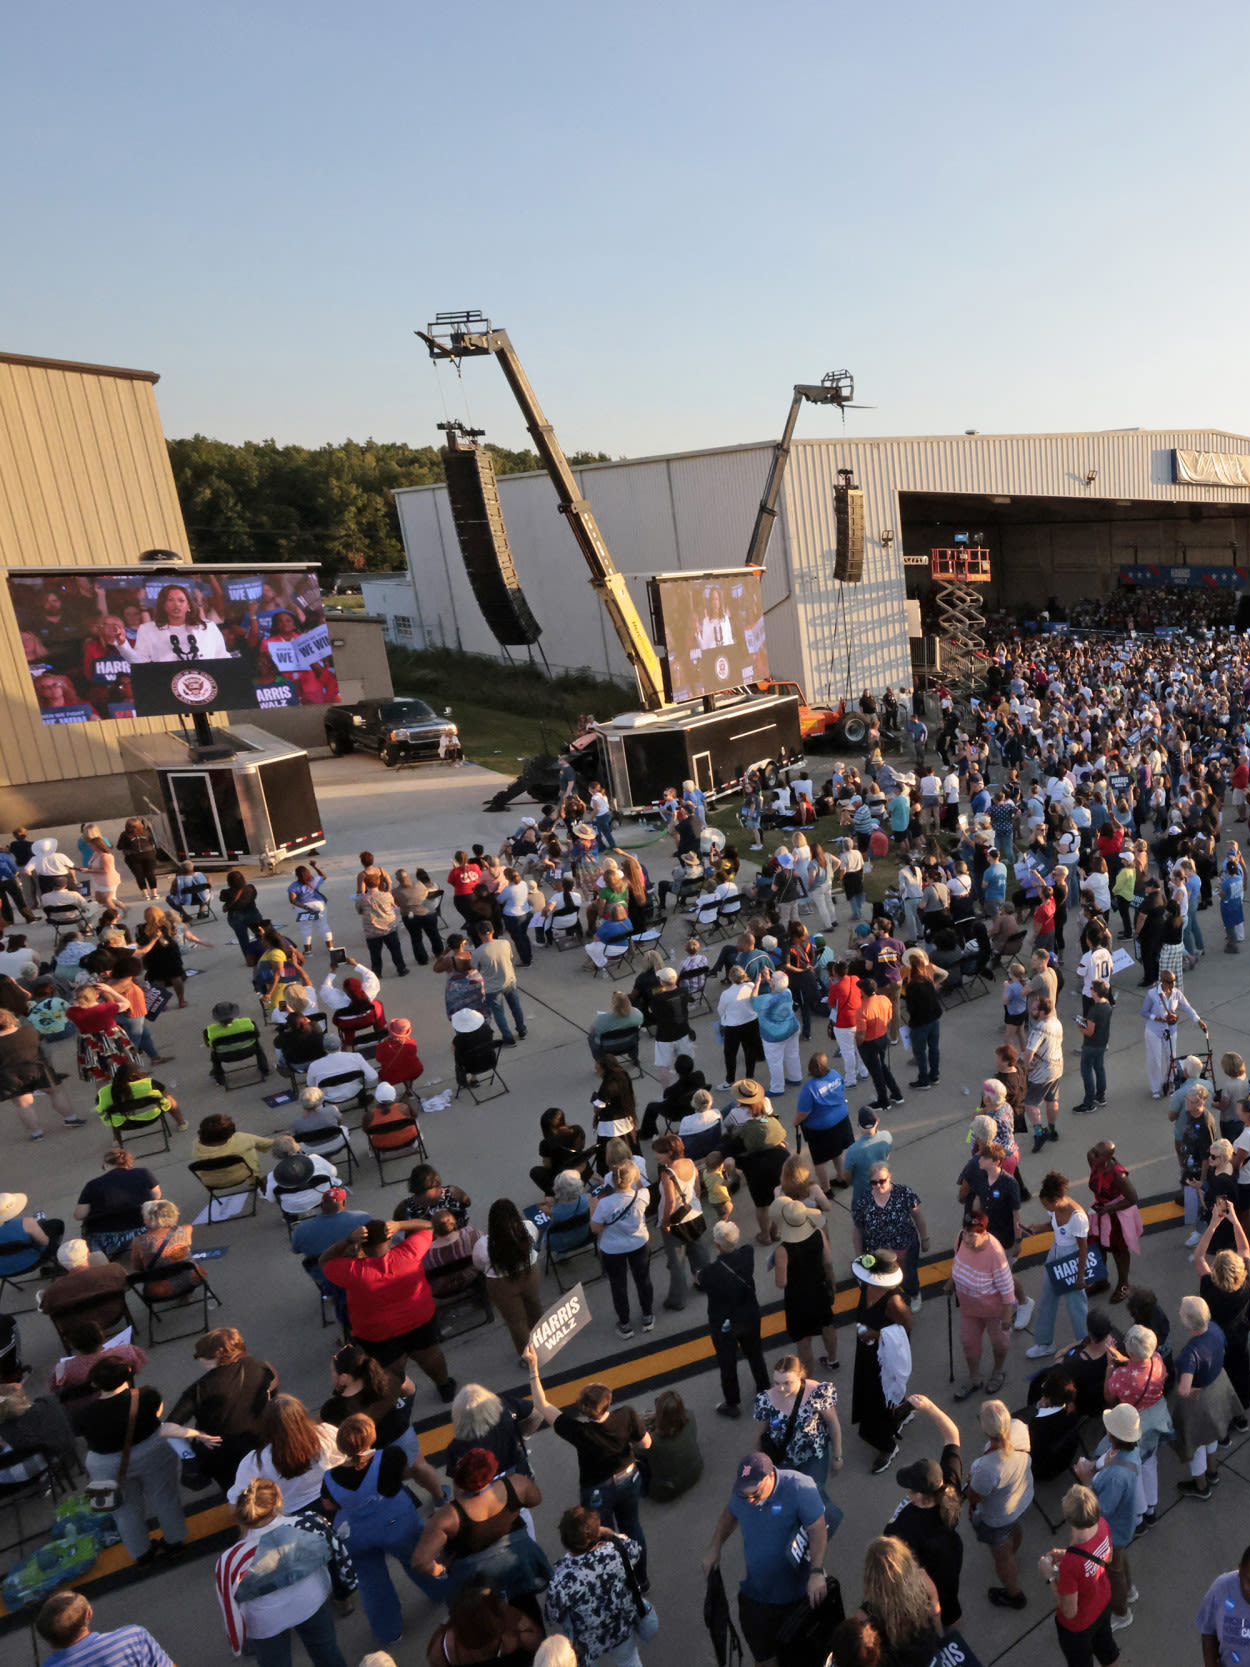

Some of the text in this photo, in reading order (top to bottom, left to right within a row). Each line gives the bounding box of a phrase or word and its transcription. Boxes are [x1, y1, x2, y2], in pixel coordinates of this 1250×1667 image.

[276, 652, 294, 664] WE
[299, 644, 316, 658] WE
[96, 661, 132, 674] HARR
[256, 686, 292, 702] ARRIS
[1095, 961, 1109, 978] 10
[1053, 1252, 1098, 1280] HARIS
[1065, 1270, 1095, 1286] WZ
[532, 1296, 581, 1348] HARRIS
[544, 1319, 577, 1350] WALZ
